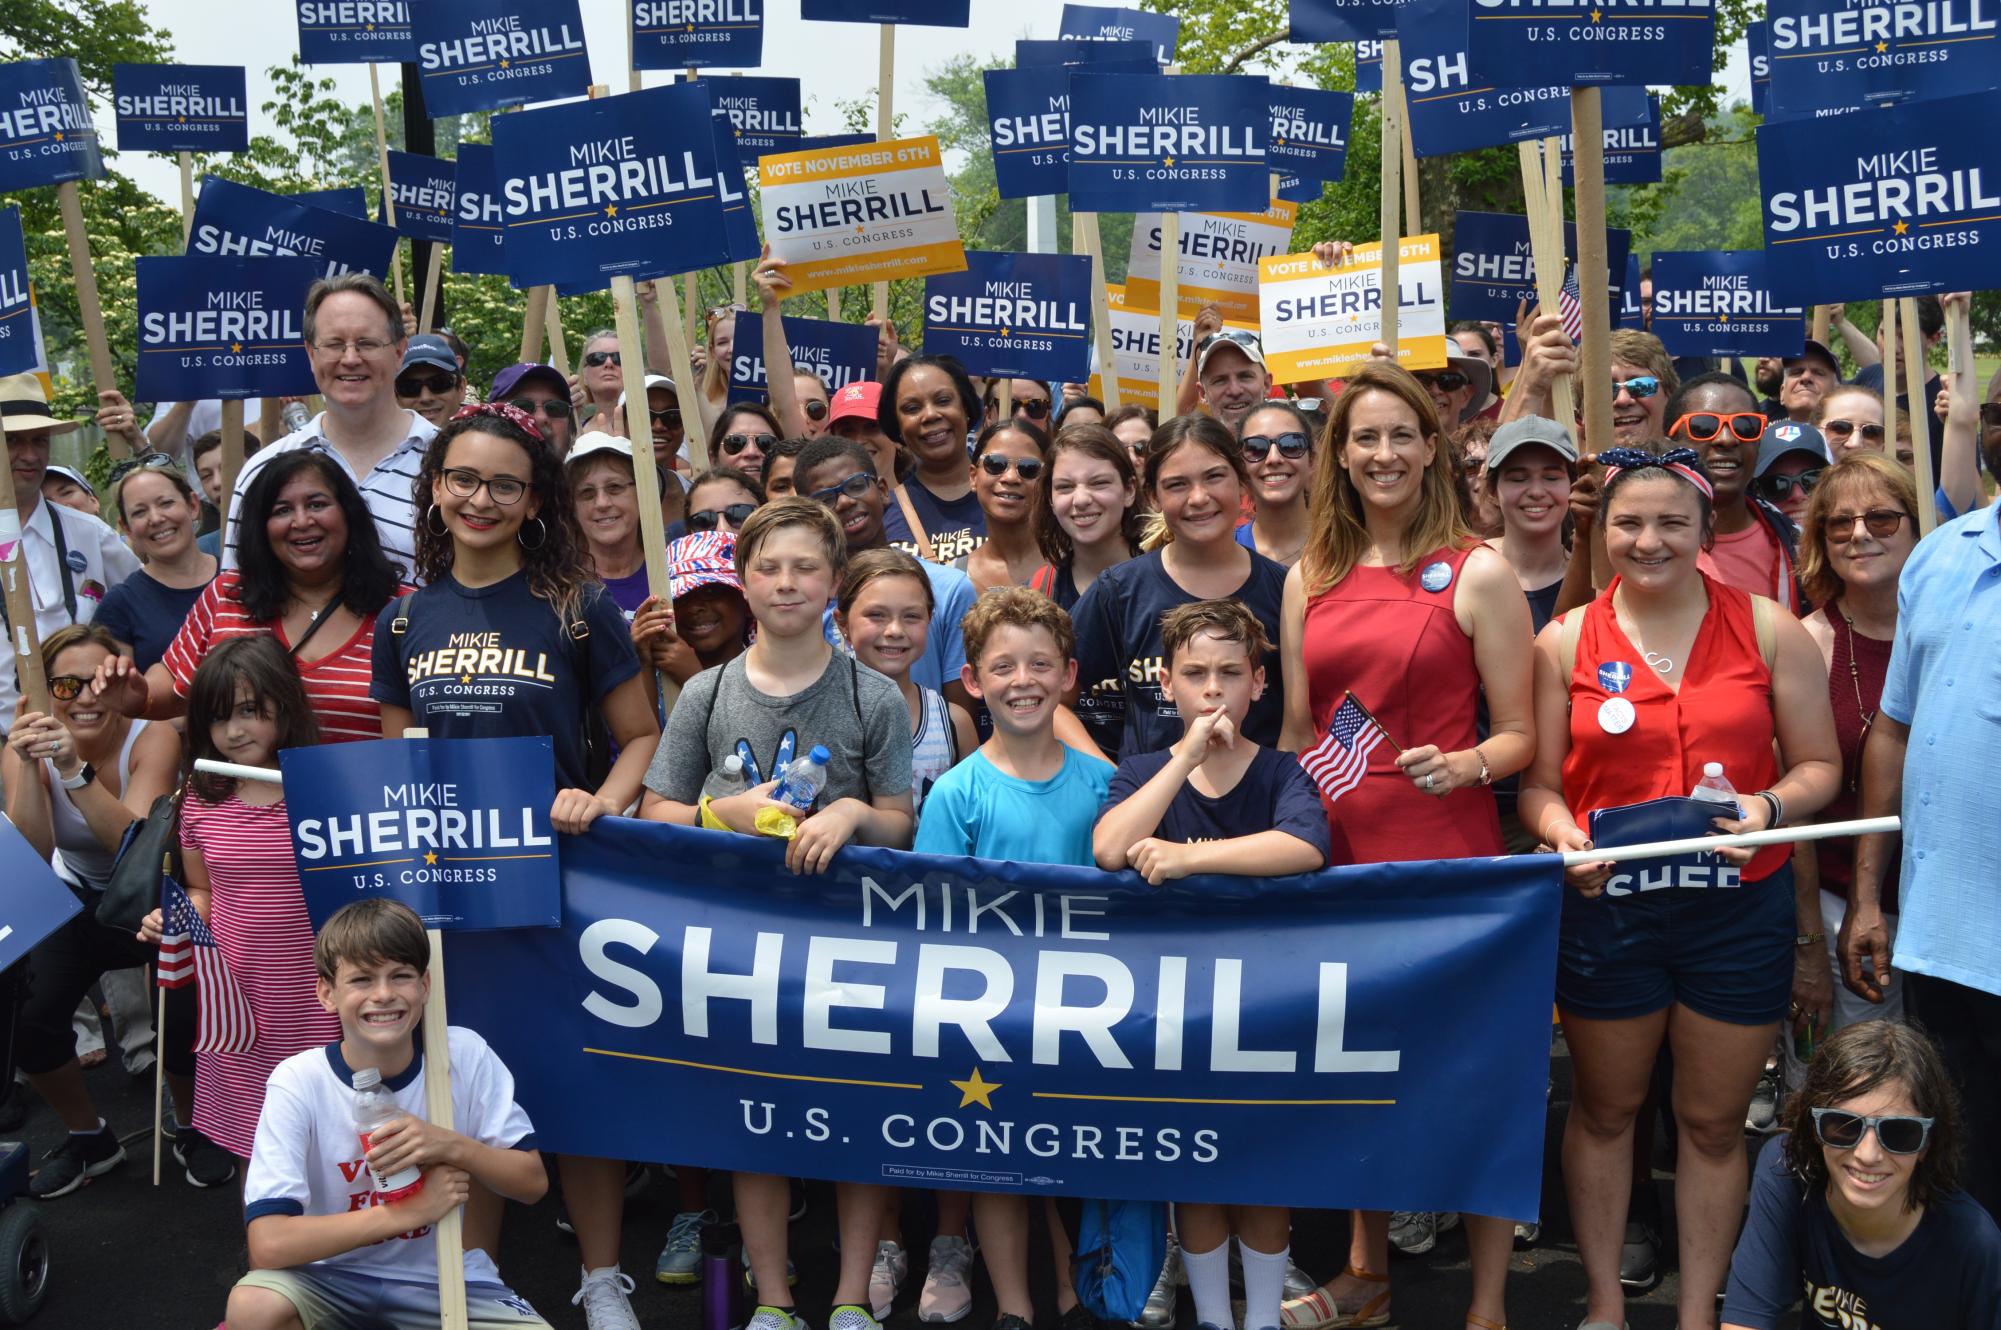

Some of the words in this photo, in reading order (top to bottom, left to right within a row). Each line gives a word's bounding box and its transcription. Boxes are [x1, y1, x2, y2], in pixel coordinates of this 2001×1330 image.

[300, 2, 410, 25] SHERRI
[635, 0, 759, 27] SHERRILL
[471, 15, 522, 36] MIKIE
[1100, 25, 1134, 39] MIKIE
[1527, 27, 1562, 41] U.S.
[1569, 26, 1665, 41] CONGRESS
[1773, 0, 1996, 50] SHERRILL
[330, 32, 351, 41] U.S.
[354, 31, 412, 41] CONGRESS
[661, 35, 677, 44] U.S.
[678, 33, 731, 43] CONGRESS
[419, 24, 583, 70] SHERRILL
[1817, 60, 1850, 73] U.S.
[1856, 49, 1949, 70] CONGRESS
[458, 75, 483, 86] U.S.
[487, 64, 553, 82] CONGRESS
[20, 87, 68, 108] MIKIE
[160, 84, 200, 97] MIKIE
[1459, 98, 1491, 113] U.S.
[1499, 86, 1570, 107] CONGRE
[117, 95, 245, 117] SHERRILL
[720, 96, 758, 110] MIKIE
[1269, 104, 1305, 121] MIKIE
[0, 103, 94, 139] HERRILL
[711, 109, 799, 131] RRILL
[1140, 107, 1199, 125] MIKIE
[144, 123, 164, 132] U.S.
[168, 123, 220, 132] CONGRESS
[1269, 117, 1345, 146] RRILL
[9, 148, 36, 160] U.S.
[41, 141, 87, 155] CONGRESS
[737, 138, 775, 147] NGRESS
[1074, 125, 1266, 156] SHERRILL
[570, 136, 637, 167] MIKIE
[766, 161, 802, 177] VOTE
[805, 151, 894, 174] NOVEMBER
[897, 146, 930, 163] 6TH
[1032, 154, 1059, 165] U.S.
[1603, 156, 1633, 164] GRESS
[1112, 169, 1141, 180] U.S.
[1146, 168, 1227, 180] CONGRESS
[1857, 147, 1939, 180] MIKIE
[427, 177, 456, 192] MIKI
[504, 151, 714, 216] SHERRILL
[826, 179, 880, 200] MIKIE
[776, 189, 944, 232] SHERRILL
[1769, 168, 2001, 233] SHERRIL
[406, 211, 424, 220] U.S.
[426, 215, 454, 225] CONG
[550, 225, 582, 241] U.S.
[588, 212, 673, 236] CONGRESS
[1203, 219, 1248, 238] MIKIE
[265, 225, 326, 256] MIKIE
[813, 239, 838, 250] U.S.
[843, 228, 914, 247] CONGRESS
[1826, 245, 1864, 259] U.S.
[1872, 230, 1980, 254] CONGRESS
[806, 254, 928, 279] www.mikiesherrill.com
[1267, 259, 1309, 276] VOTE
[1400, 243, 1431, 258] 6TH
[1203, 269, 1254, 285] CONGRESS
[1329, 273, 1377, 293] MIKIE
[1703, 275, 1749, 290] MIKIE
[207, 291, 264, 309] MIKIE
[985, 281, 1032, 299] MIKIE
[1487, 289, 1511, 299] U.S.
[1276, 282, 1435, 322] SHERRLL
[928, 295, 1086, 331] SHERRILL
[143, 309, 302, 344] SHERRIL
[1308, 328, 1331, 338] U.S.
[1336, 319, 1403, 335] CONGRS
[1683, 323, 1704, 332] U.S.
[1708, 323, 1769, 333] CONGRESS
[787, 345, 831, 363] MIKIE
[961, 336, 992, 348] U.S.
[995, 337, 1053, 351] CONGRESS
[181, 357, 207, 368] U.S.
[212, 353, 287, 367] CONGRESS
[931, 527, 971, 544] MIKIE
[449, 632, 501, 648] MIKIE
[408, 648, 555, 686] SHERRILL
[419, 687, 439, 698] U.S.
[443, 684, 516, 696] CONGRESS
[384, 783, 458, 808] MIKIE
[298, 807, 552, 860] SHERRILL
[354, 873, 391, 889] U.S.
[400, 868, 497, 885] CONGRESS
[861, 876, 1110, 940] MIKIE
[578, 918, 1401, 1073] SHERRILL
[740, 1099, 850, 1143] U.S.
[881, 1114, 1220, 1163] CONGRESS
[889, 1167, 905, 1175] Paid
[916, 1169, 925, 1177] by
[946, 1171, 969, 1179] Sherrill
[981, 1174, 1014, 1182] Congress
